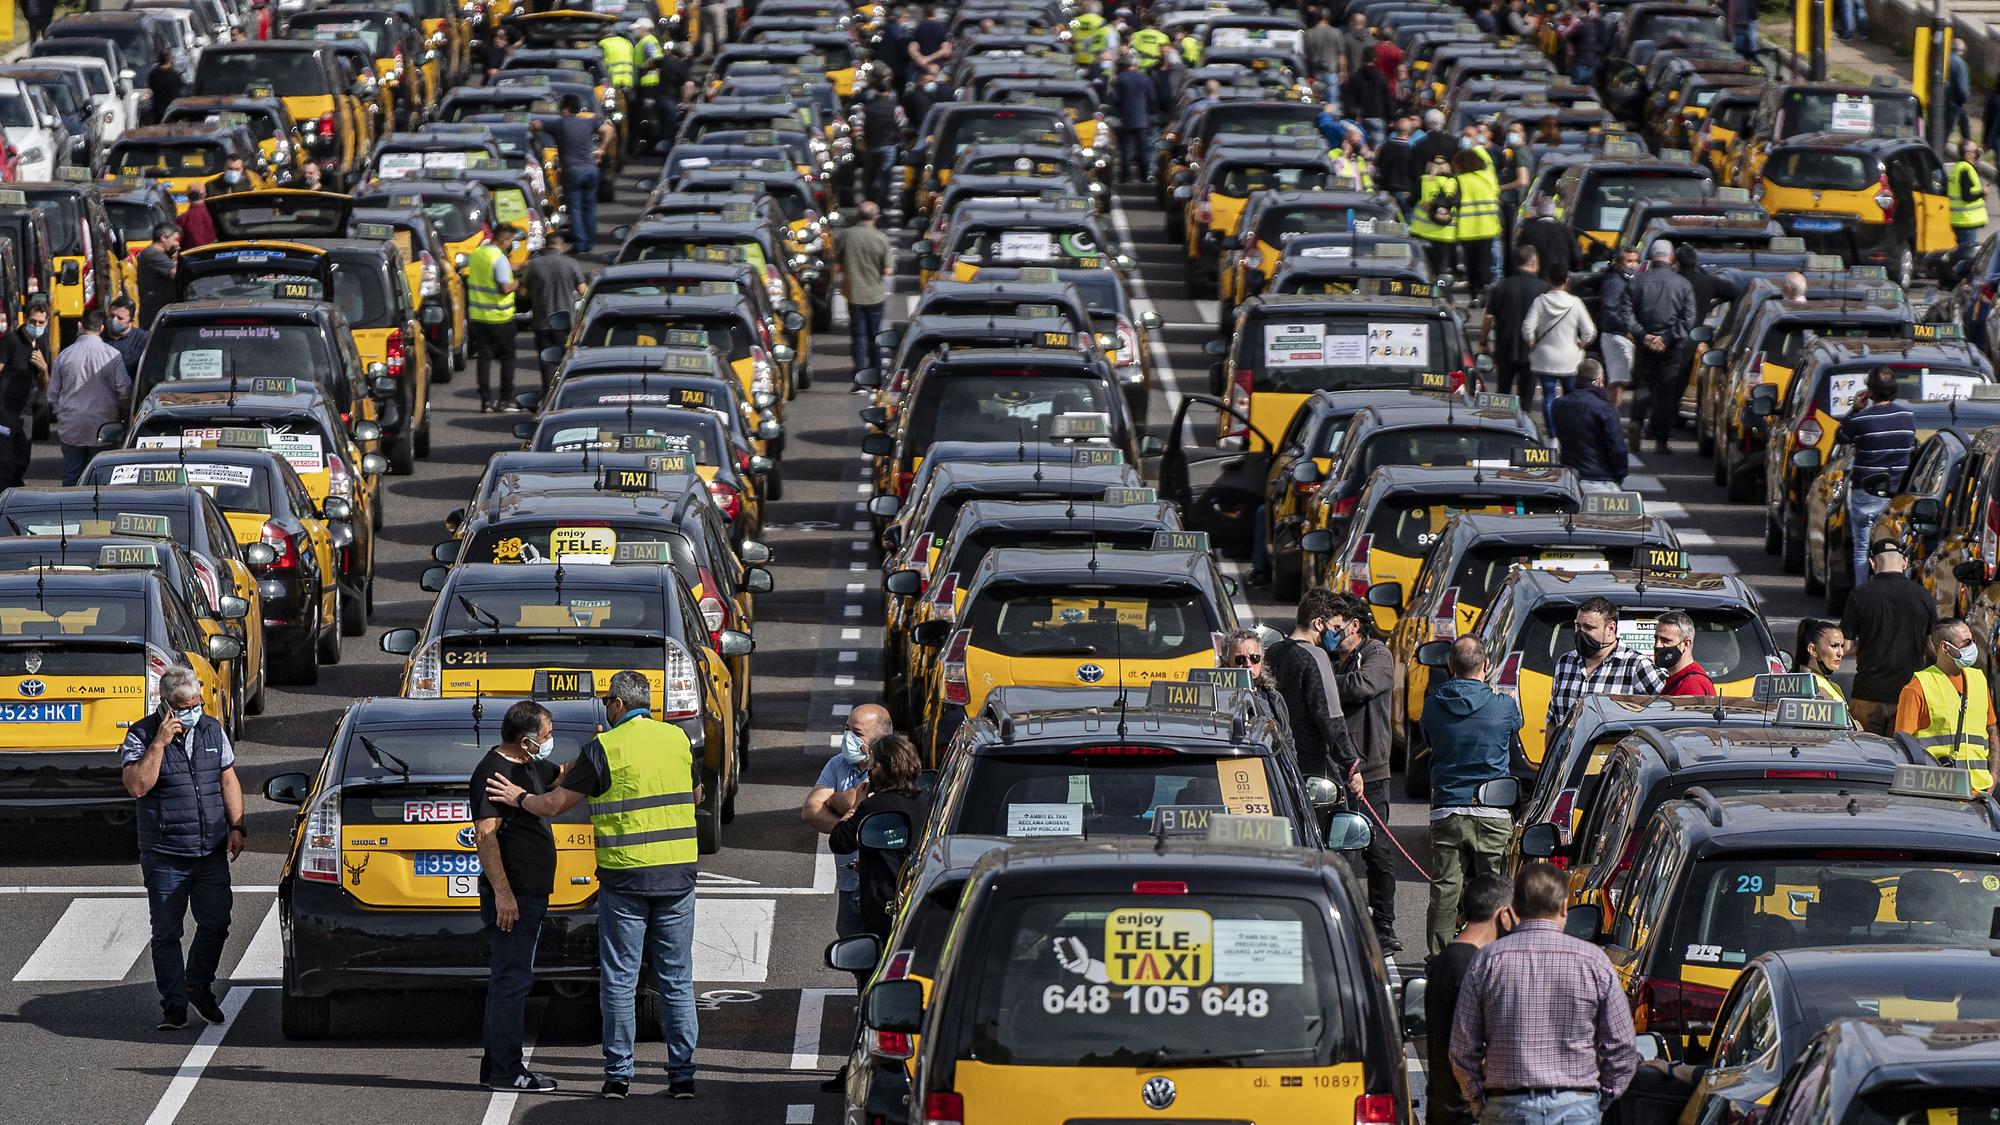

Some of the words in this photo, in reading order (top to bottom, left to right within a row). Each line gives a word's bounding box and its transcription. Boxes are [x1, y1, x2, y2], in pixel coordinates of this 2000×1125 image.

[286, 285, 307, 298] TAXI
[1369, 329, 1393, 341] APP
[1914, 325, 1934, 337] TAXI
[1045, 333, 1068, 346] TAXI
[679, 357, 701, 367] TAXI
[266, 380, 285, 391] TAXI
[1422, 373, 1444, 386] TAXI
[1832, 380, 1855, 389] APP
[681, 390, 704, 403] TAXI
[1490, 396, 1510, 407] TAXI
[236, 431, 257, 442] TAXI
[634, 436, 656, 448] TAXI
[1090, 452, 1112, 464] TAXI
[1524, 449, 1550, 462] TAXI
[660, 457, 684, 470] TAXI
[154, 469, 176, 482] TAXI
[620, 472, 646, 486] TAXI
[1122, 491, 1146, 503] TAXI
[1602, 497, 1629, 511] TAXI
[132, 518, 156, 532] TAXI
[557, 530, 586, 540] enjoy
[502, 542, 519, 554] 58
[556, 540, 602, 552] TELE
[1171, 535, 1196, 549] TAXI
[119, 549, 144, 562] TAXI
[633, 546, 658, 559] TAXI
[1546, 551, 1575, 559] enjoy
[1649, 550, 1678, 566] TAXI
[445, 651, 488, 665] C-211
[549, 674, 578, 691] TAXI
[1150, 672, 1167, 680] AMB
[1208, 672, 1236, 688] TAXI
[88, 687, 105, 695] AMB
[113, 686, 143, 695] 11005
[1773, 677, 1800, 693] TAXI
[1167, 686, 1198, 704] TAXI
[0, 705, 39, 720] 523
[45, 705, 78, 720] HKT
[1800, 703, 1831, 721] TAXI
[1921, 771, 1953, 791] TAXI
[1245, 803, 1270, 814] 933
[1235, 819, 1272, 841] TAXI
[428, 855, 480, 873] 3598
[455, 876, 471, 894] S
[1736, 875, 1763, 893] 29
[1116, 913, 1164, 928] enjoy
[1115, 931, 1191, 950] TELE
[1042, 986, 1110, 1015] 648
[1123, 986, 1190, 1015] 105
[1200, 988, 1269, 1017] 648
[1313, 1075, 1360, 1088] 10897
